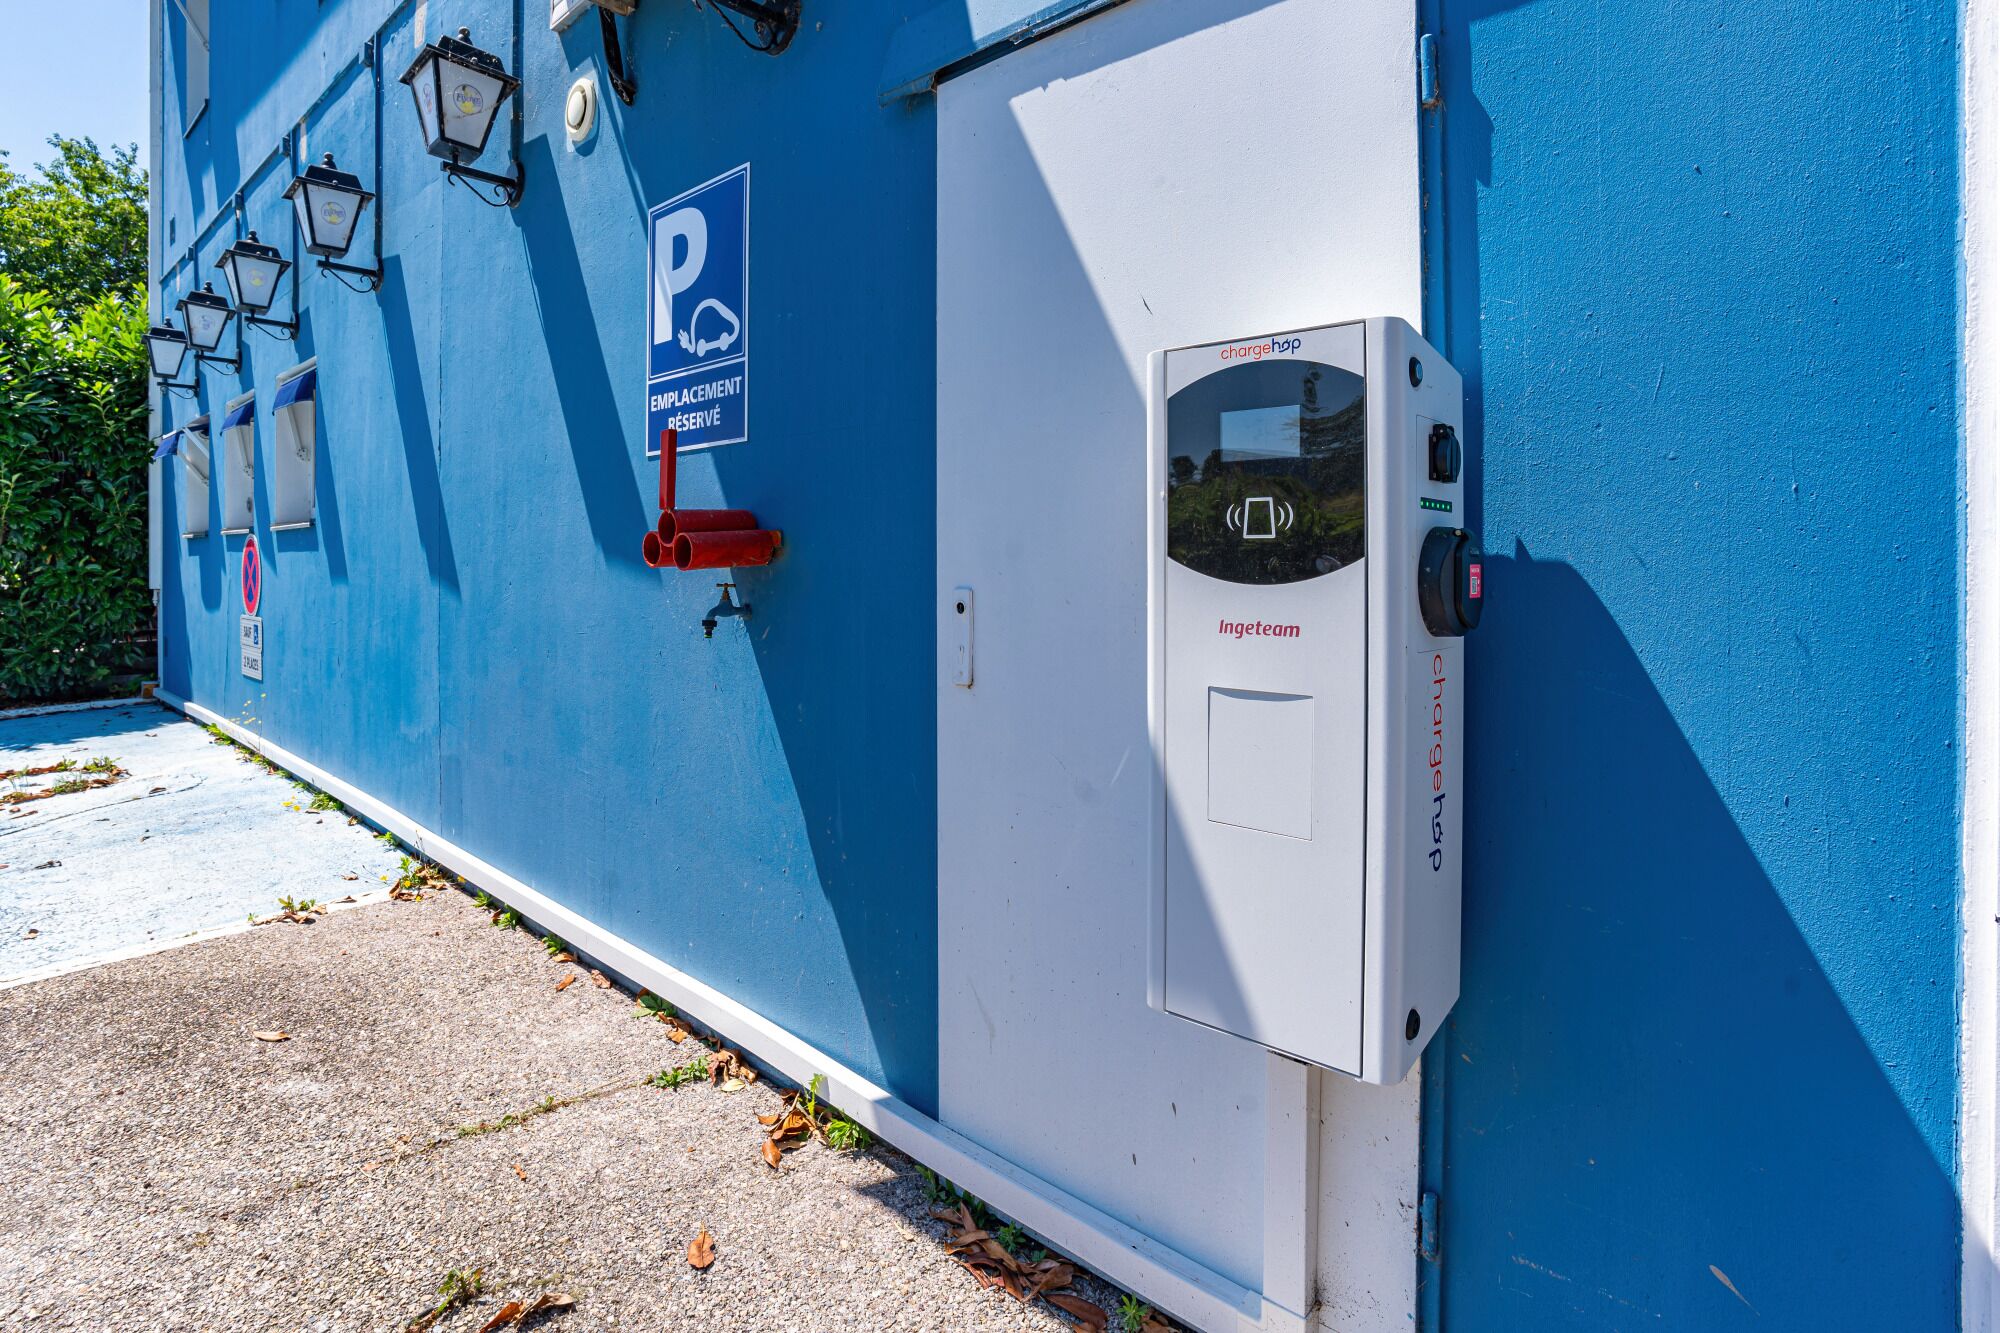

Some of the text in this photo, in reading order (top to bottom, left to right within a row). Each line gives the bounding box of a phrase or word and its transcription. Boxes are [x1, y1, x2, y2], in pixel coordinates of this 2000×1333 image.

[654, 207, 708, 345] P
[651, 376, 742, 412] EMPLACEMENT
[668, 404, 721, 432] RÉSERVÉ
[1219, 619, 1300, 639] Ingeteam
